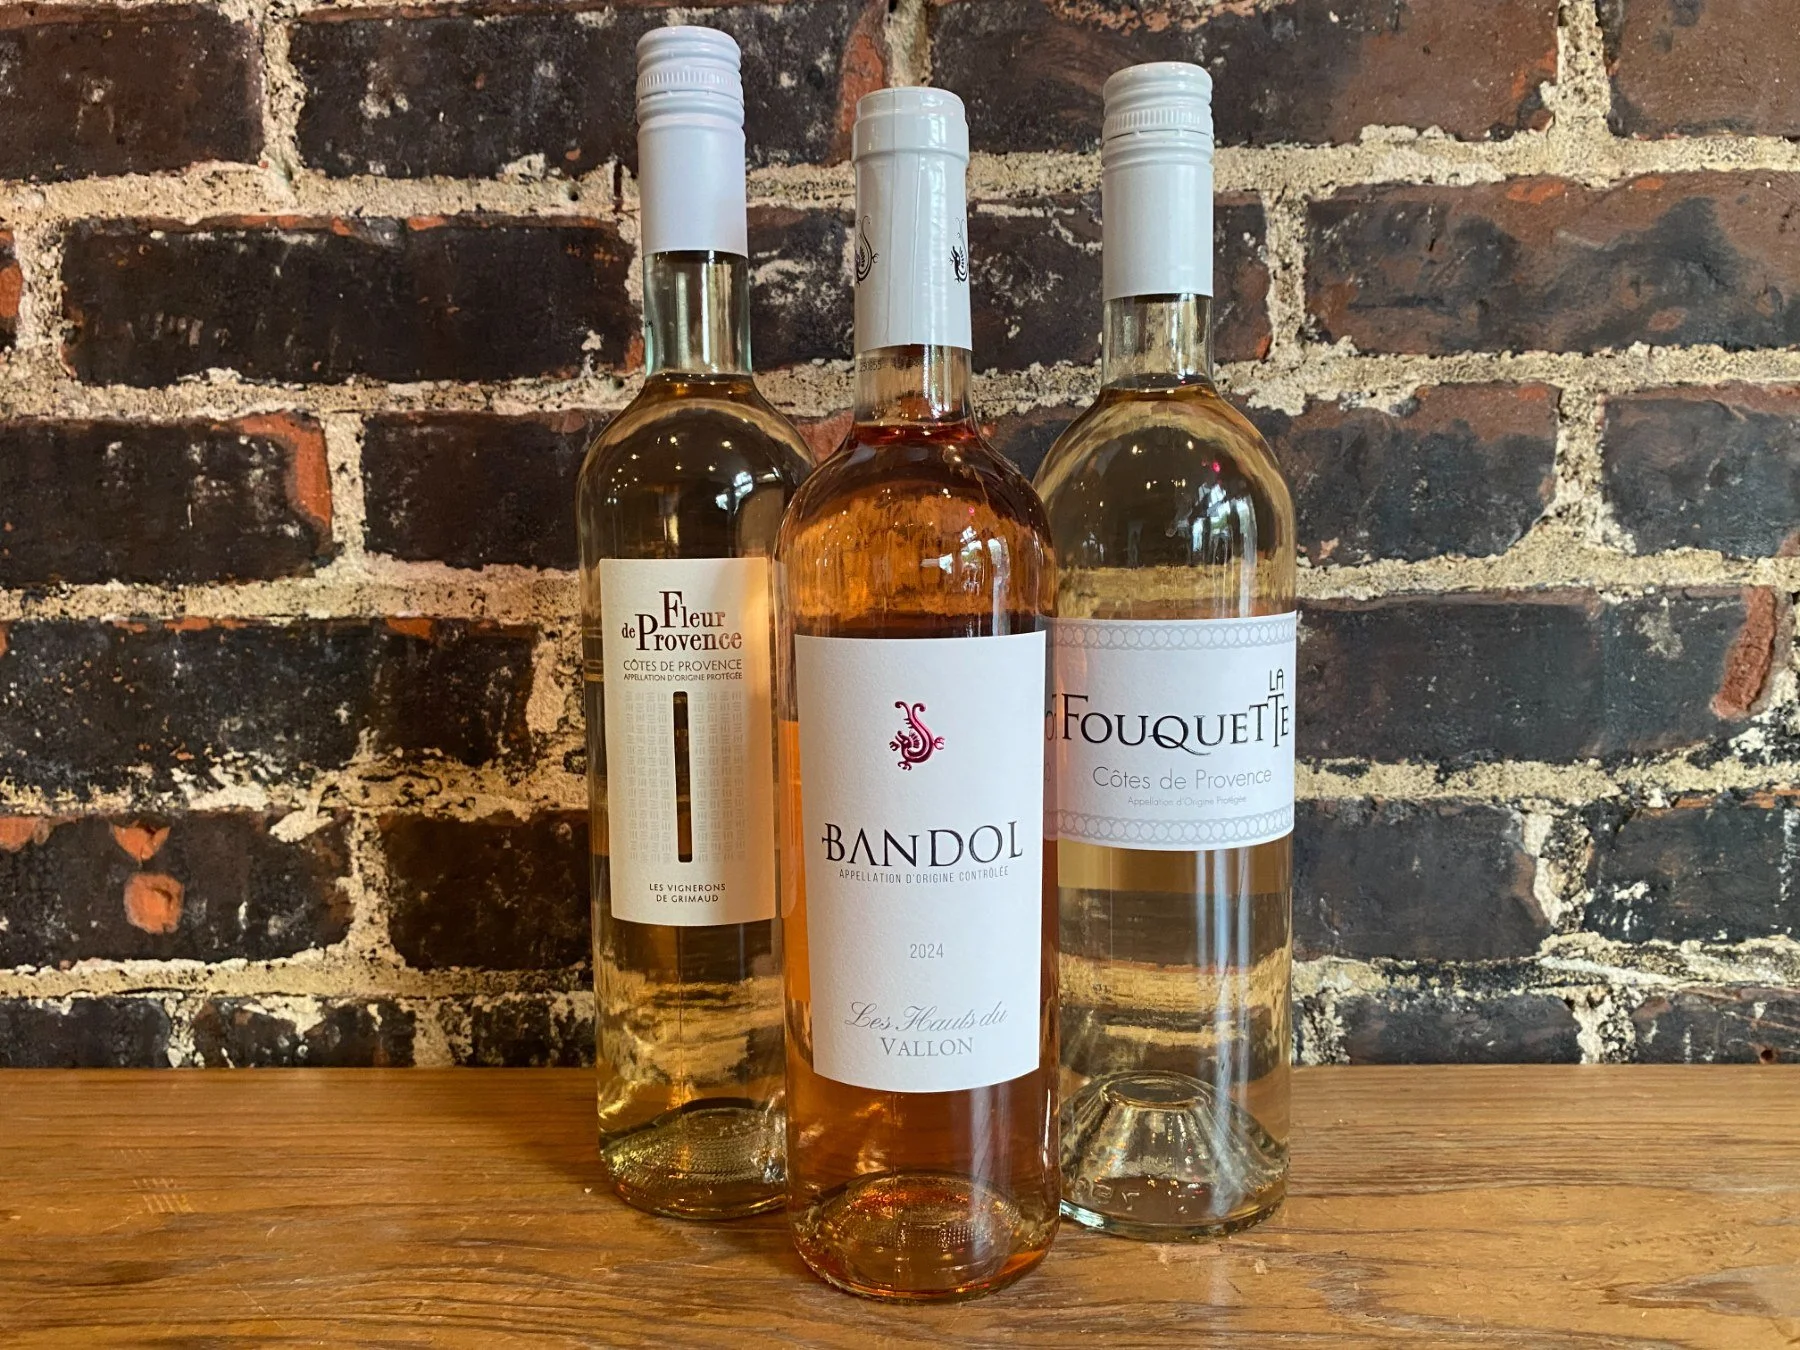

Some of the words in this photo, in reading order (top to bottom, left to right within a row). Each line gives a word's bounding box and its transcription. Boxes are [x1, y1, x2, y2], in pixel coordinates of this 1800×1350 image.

[658, 590, 726, 628] Fleur
[621, 622, 636, 639] de
[634, 613, 743, 651] Provence
[623, 658, 657, 672] CÔTES
[660, 660, 675, 672] DE
[678, 658, 743, 672] PROVENCE
[623, 673, 666, 681] APPELLATION
[1269, 668, 1285, 691] LA
[1061, 692, 1290, 756] FOUQUETTE
[1092, 765, 1151, 789] Côtes
[1159, 767, 1187, 791] de
[1195, 767, 1273, 790] Provence
[821, 820, 1024, 868] BANDOL
[839, 868, 902, 884] APPELLATION
[905, 871, 955, 884] D'ORIGINE
[958, 865, 1009, 882] CONTRÔLÉE
[649, 883, 664, 892] LES
[667, 883, 726, 892] VIGNERONS
[656, 893, 668, 903] DE
[671, 893, 719, 903] GRIMAUD
[909, 942, 945, 959] 2024
[844, 1000, 894, 1031] Les
[894, 1005, 976, 1032] Hauts
[978, 1000, 1008, 1028] du
[880, 1036, 974, 1057] VALLON
